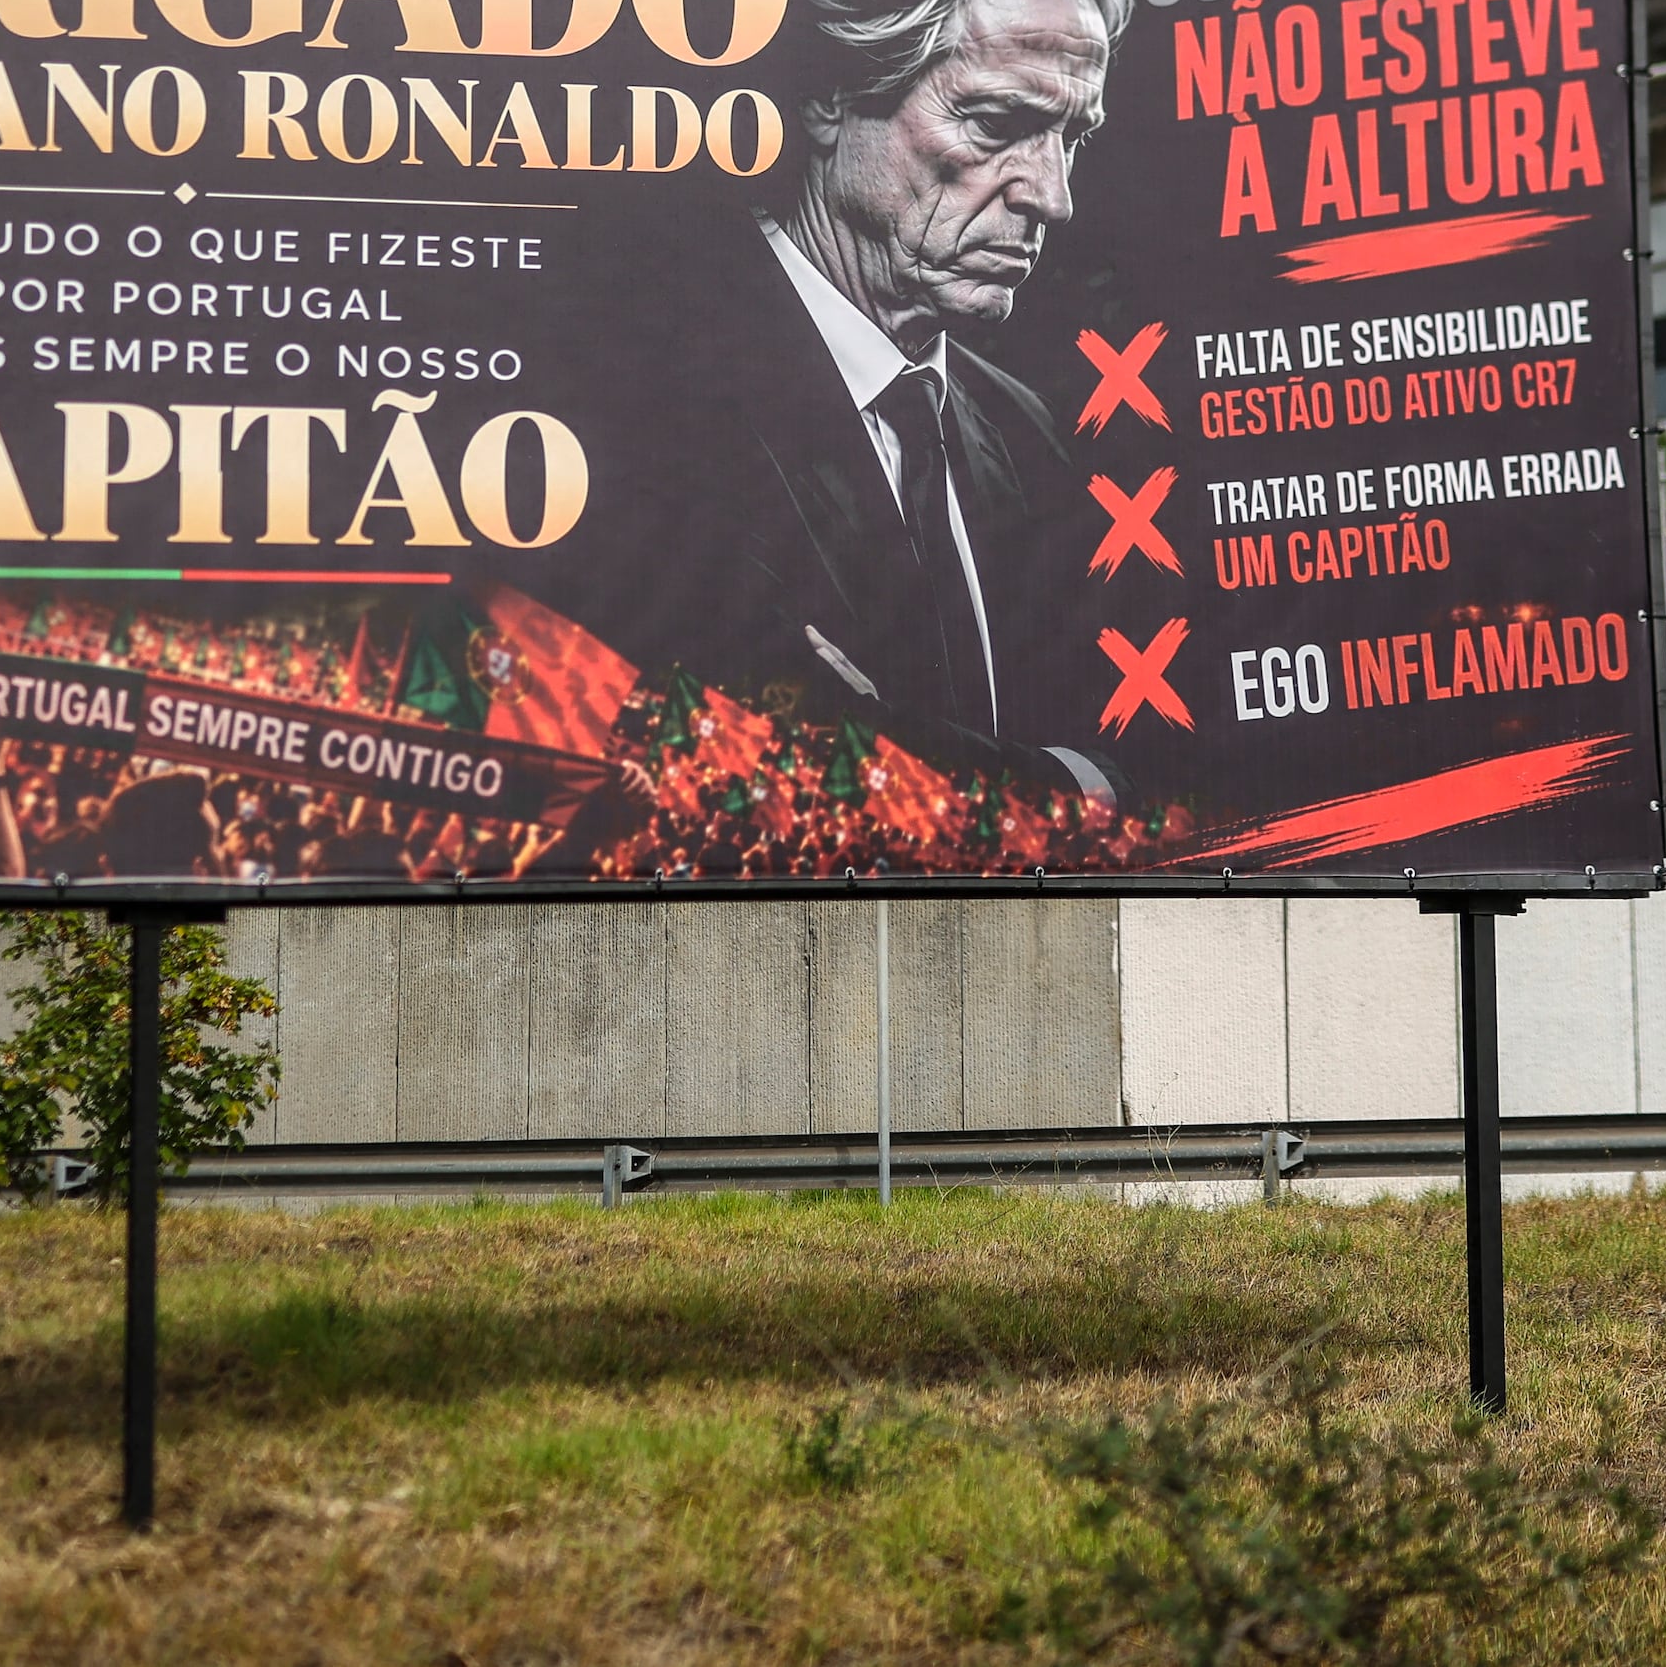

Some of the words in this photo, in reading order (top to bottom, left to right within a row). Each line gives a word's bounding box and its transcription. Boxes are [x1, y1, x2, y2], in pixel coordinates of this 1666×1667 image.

[237, 71, 785, 177] RONALDO
[1220, 111, 1276, 237] À
[1301, 81, 1604, 227] ALTURA
[127, 226, 164, 260] O
[190, 227, 299, 268] QUE
[332, 233, 544, 270] FIZESTE
[113, 282, 402, 323] PORTUGAL
[1195, 330, 1291, 378] FALTA
[1301, 323, 1341, 368] DE
[1350, 299, 1591, 364] SENSIBILIDADE
[33, 337, 249, 375] SEMPRE
[274, 341, 312, 376] O
[337, 344, 522, 381] NOSSO
[1200, 377, 1334, 439] GESTÃO
[1346, 377, 1392, 426] DO
[1404, 367, 1503, 421] ATIVO
[1512, 359, 1578, 411] CR7
[1207, 473, 1327, 525] TRATAR
[1338, 469, 1377, 514] DE
[1385, 459, 1494, 509] FORMA
[1503, 446, 1625, 499] ERRADA
[1214, 532, 1276, 590] UM
[1288, 513, 1450, 583] CAPITÃO
[1230, 643, 1330, 721] EGO
[1340, 613, 1630, 710] INFLAMADO
[146, 695, 310, 763] SEMPRE
[319, 728, 503, 797] CONTIGO
